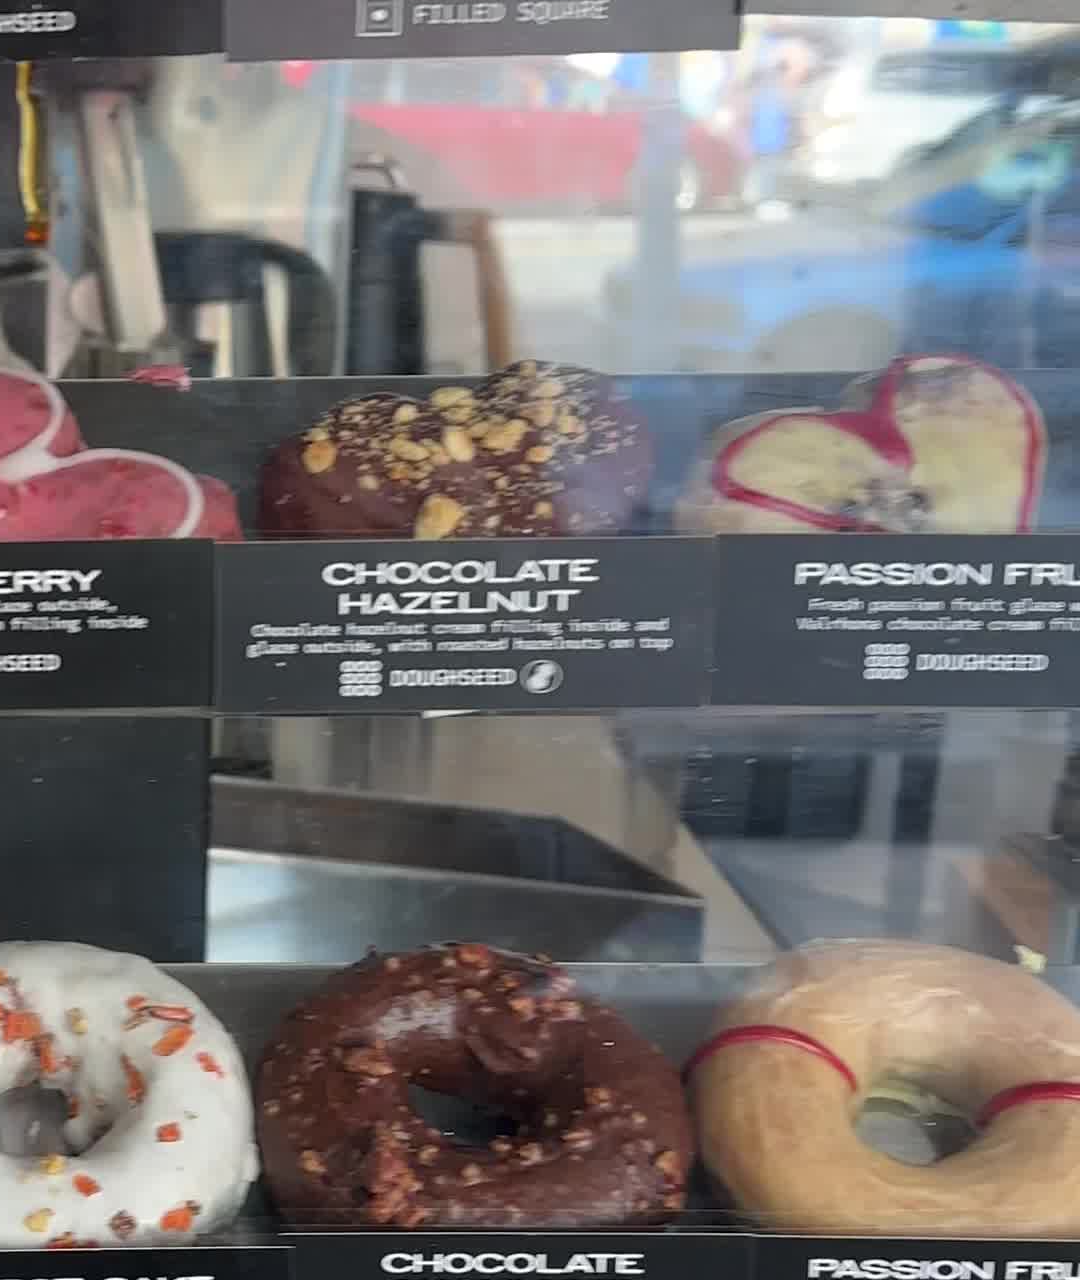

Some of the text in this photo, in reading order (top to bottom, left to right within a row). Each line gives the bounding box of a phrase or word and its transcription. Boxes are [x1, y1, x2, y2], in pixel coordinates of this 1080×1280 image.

[412, 0, 611, 25] FILLED SQUARE
[321, 559, 600, 586] CHOCOLATE
[794, 562, 993, 586] PASSION
[338, 589, 581, 615] HAZELNUT
[916, 653, 1049, 671] DOUGHSEED
[389, 669, 517, 687] DOUGHSEED
[381, 1253, 645, 1275] CHOCOLATE
[807, 1258, 996, 1280] PASSION
